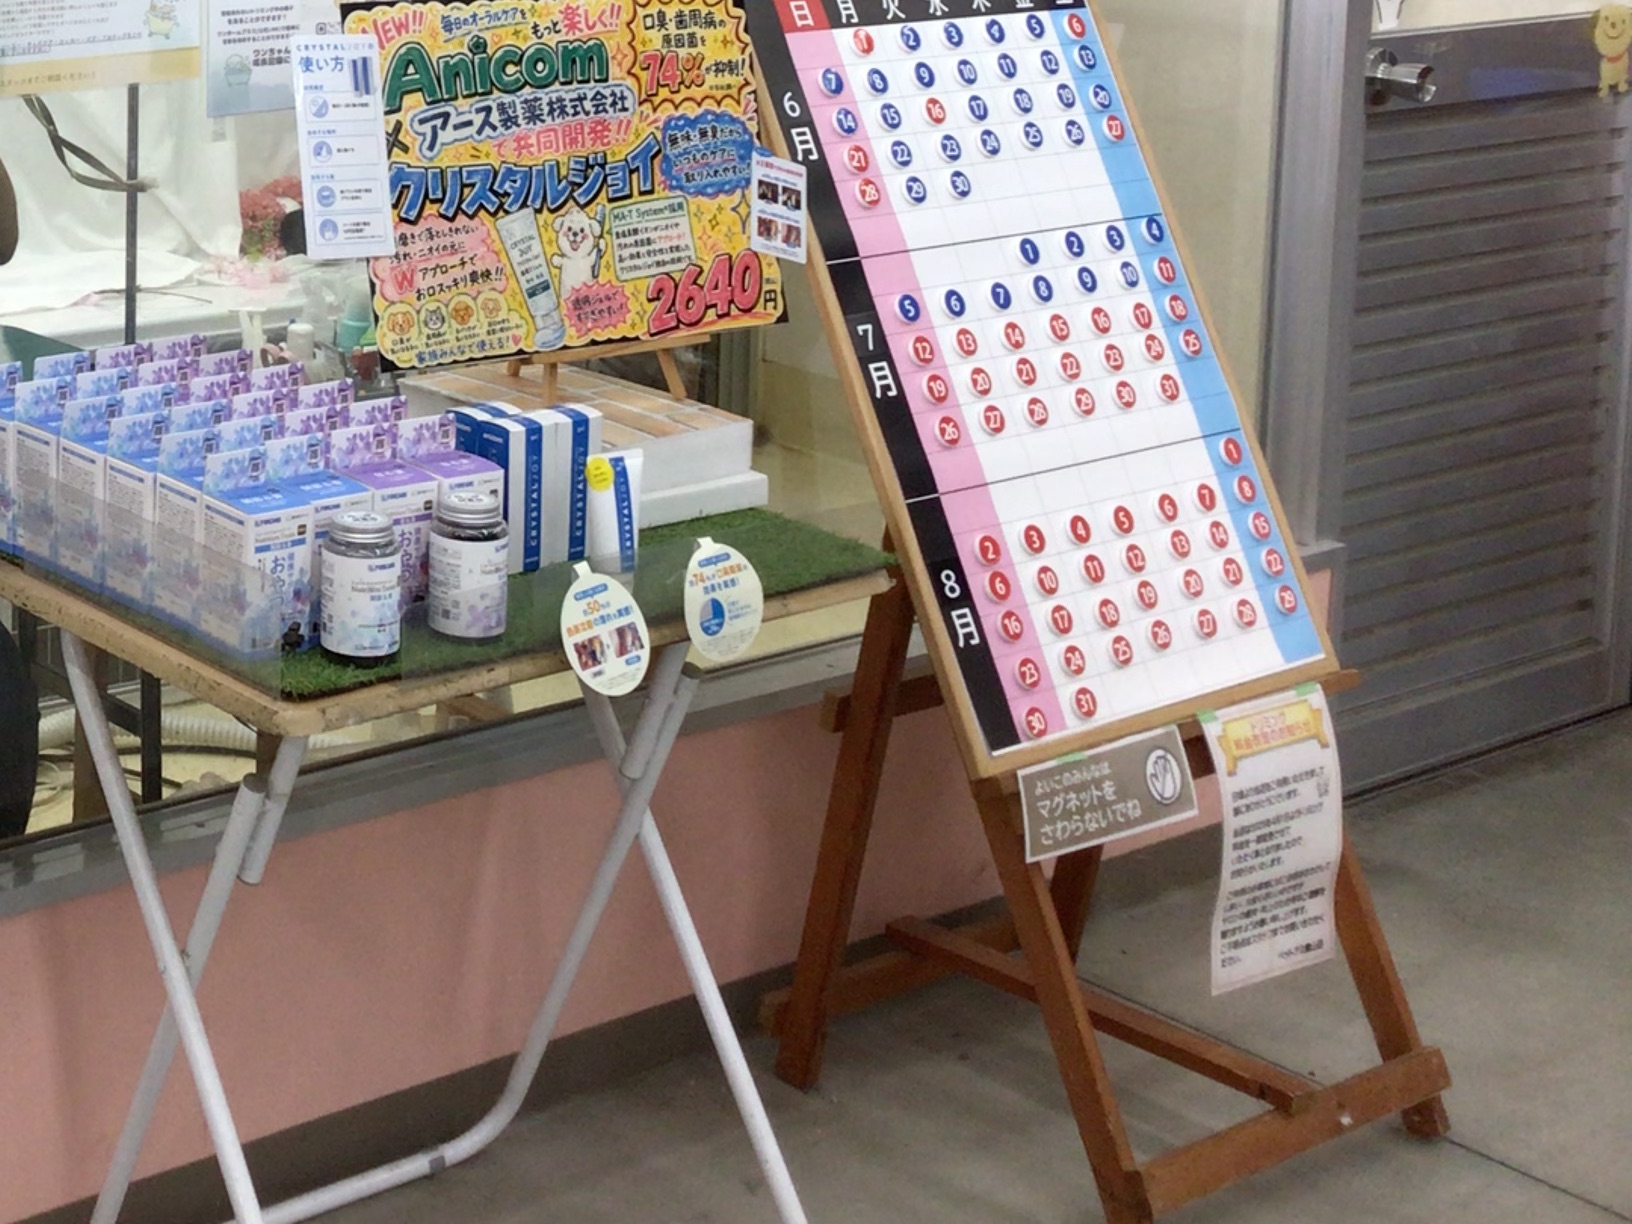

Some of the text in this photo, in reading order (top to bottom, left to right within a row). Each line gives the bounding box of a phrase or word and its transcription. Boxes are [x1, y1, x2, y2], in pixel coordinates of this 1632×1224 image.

[440, 5, 528, 36] 毎日のオーラルケアを
[642, 8, 728, 33] 口臭・歯周病の
[788, 0, 814, 28] 日
[904, 28, 916, 46] 2
[947, 26, 958, 42] 3
[1030, 19, 1040, 35] 5
[1072, 18, 1081, 32] 6
[298, 55, 346, 74] 使い方
[383, 35, 609, 114] Anicom
[414, 87, 631, 153] アース製薬株式会社
[781, 92, 820, 164] 6月
[839, 87, 1109, 129] 14 15 16 17 18 19 20
[491, 117, 632, 160] で共同開発!!
[388, 133, 664, 223] クリスタルジョイ
[396, 224, 480, 248] 磨きで落としきれない
[904, 262, 1175, 316] 5 6 7 8 9 10 11
[856, 322, 899, 400] 7月
[939, 569, 981, 650] 8月
[1005, 553, 1283, 634] 16 17 18 19 20 21 22
[1036, 780, 1117, 819] マグネットを
[1039, 798, 1143, 846] さわらないでね
